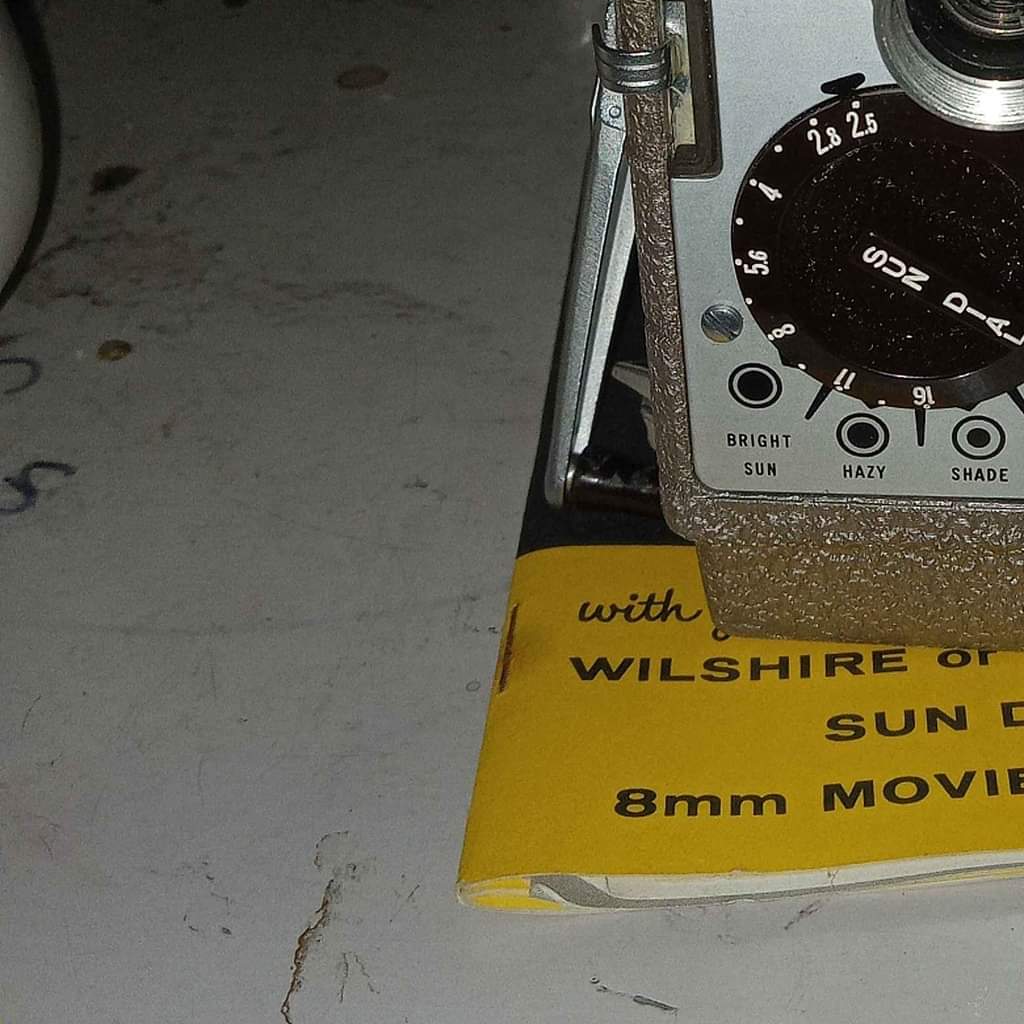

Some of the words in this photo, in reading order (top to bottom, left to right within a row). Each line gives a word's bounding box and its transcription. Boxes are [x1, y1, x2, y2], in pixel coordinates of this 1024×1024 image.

[846, 111, 879, 139] 2.5
[807, 126, 842, 156] 2.8
[758, 182, 783, 201] 4
[743, 249, 770, 276] 5.6
[862, 245, 930, 292] SUN
[833, 368, 856, 390] 11
[912, 386, 936, 407] 16
[727, 432, 792, 449] BRIGHT
[744, 461, 777, 477] SUN
[843, 464, 886, 479] HAZY
[951, 467, 1009, 483] SHADE
[578, 588, 703, 623] with
[569, 647, 908, 682] WILSHIRE
[825, 705, 968, 742] SUN
[614, 788, 787, 818] 8mm
